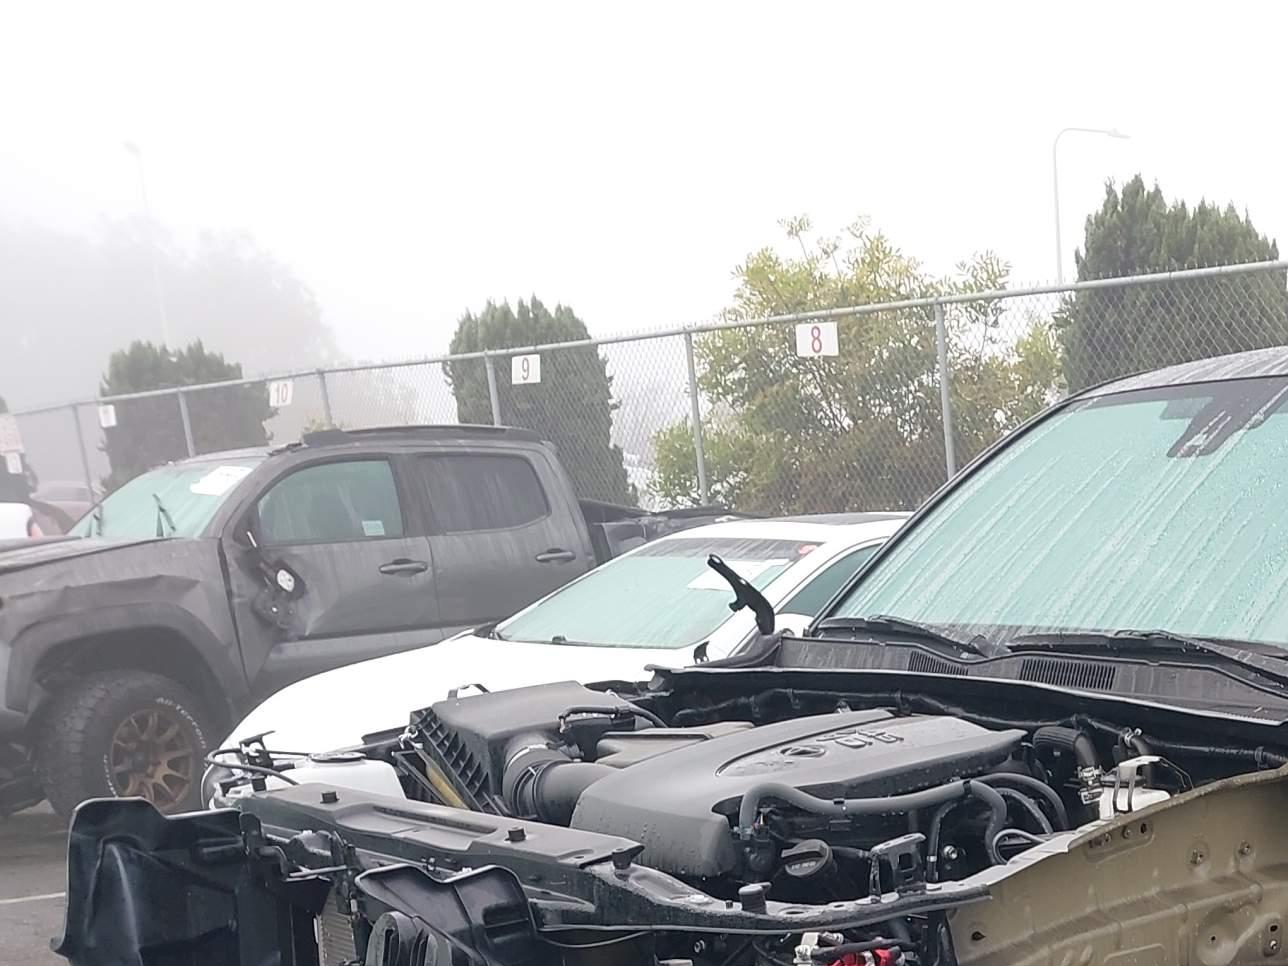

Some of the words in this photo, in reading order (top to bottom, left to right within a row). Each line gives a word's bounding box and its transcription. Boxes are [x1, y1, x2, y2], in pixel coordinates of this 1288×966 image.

[810, 325, 822, 353] 8
[521, 357, 530, 380] 9
[275, 383, 289, 404] 10
